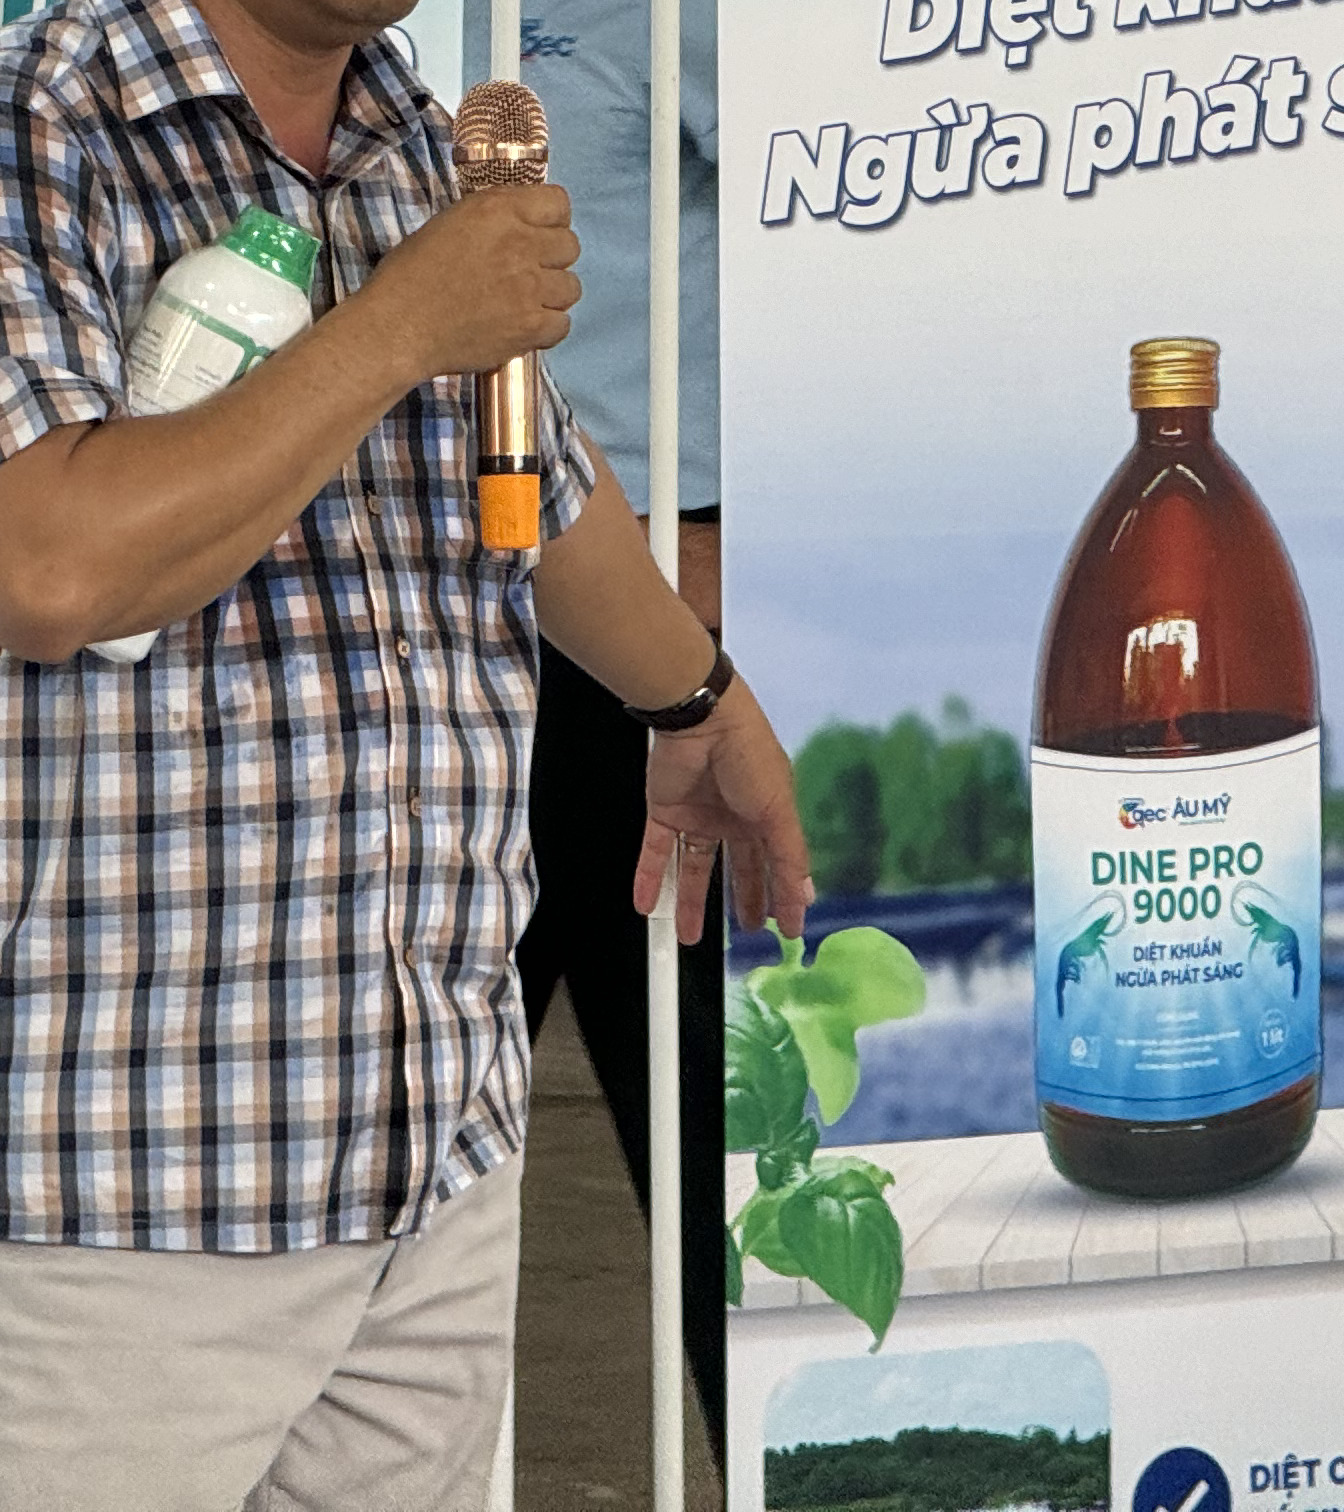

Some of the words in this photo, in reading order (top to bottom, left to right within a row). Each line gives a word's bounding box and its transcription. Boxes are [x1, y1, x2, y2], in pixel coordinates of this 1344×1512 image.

[760, 98, 1048, 228] Ngừa
[1063, 54, 1308, 197] phát
[1171, 795, 1199, 819] ÂU
[1202, 792, 1232, 816] MỸ
[1091, 848, 1178, 885] DINE
[1189, 841, 1264, 882] PRO
[1132, 884, 1222, 925] 9000
[1249, 1452, 1321, 1498] DIỆT
